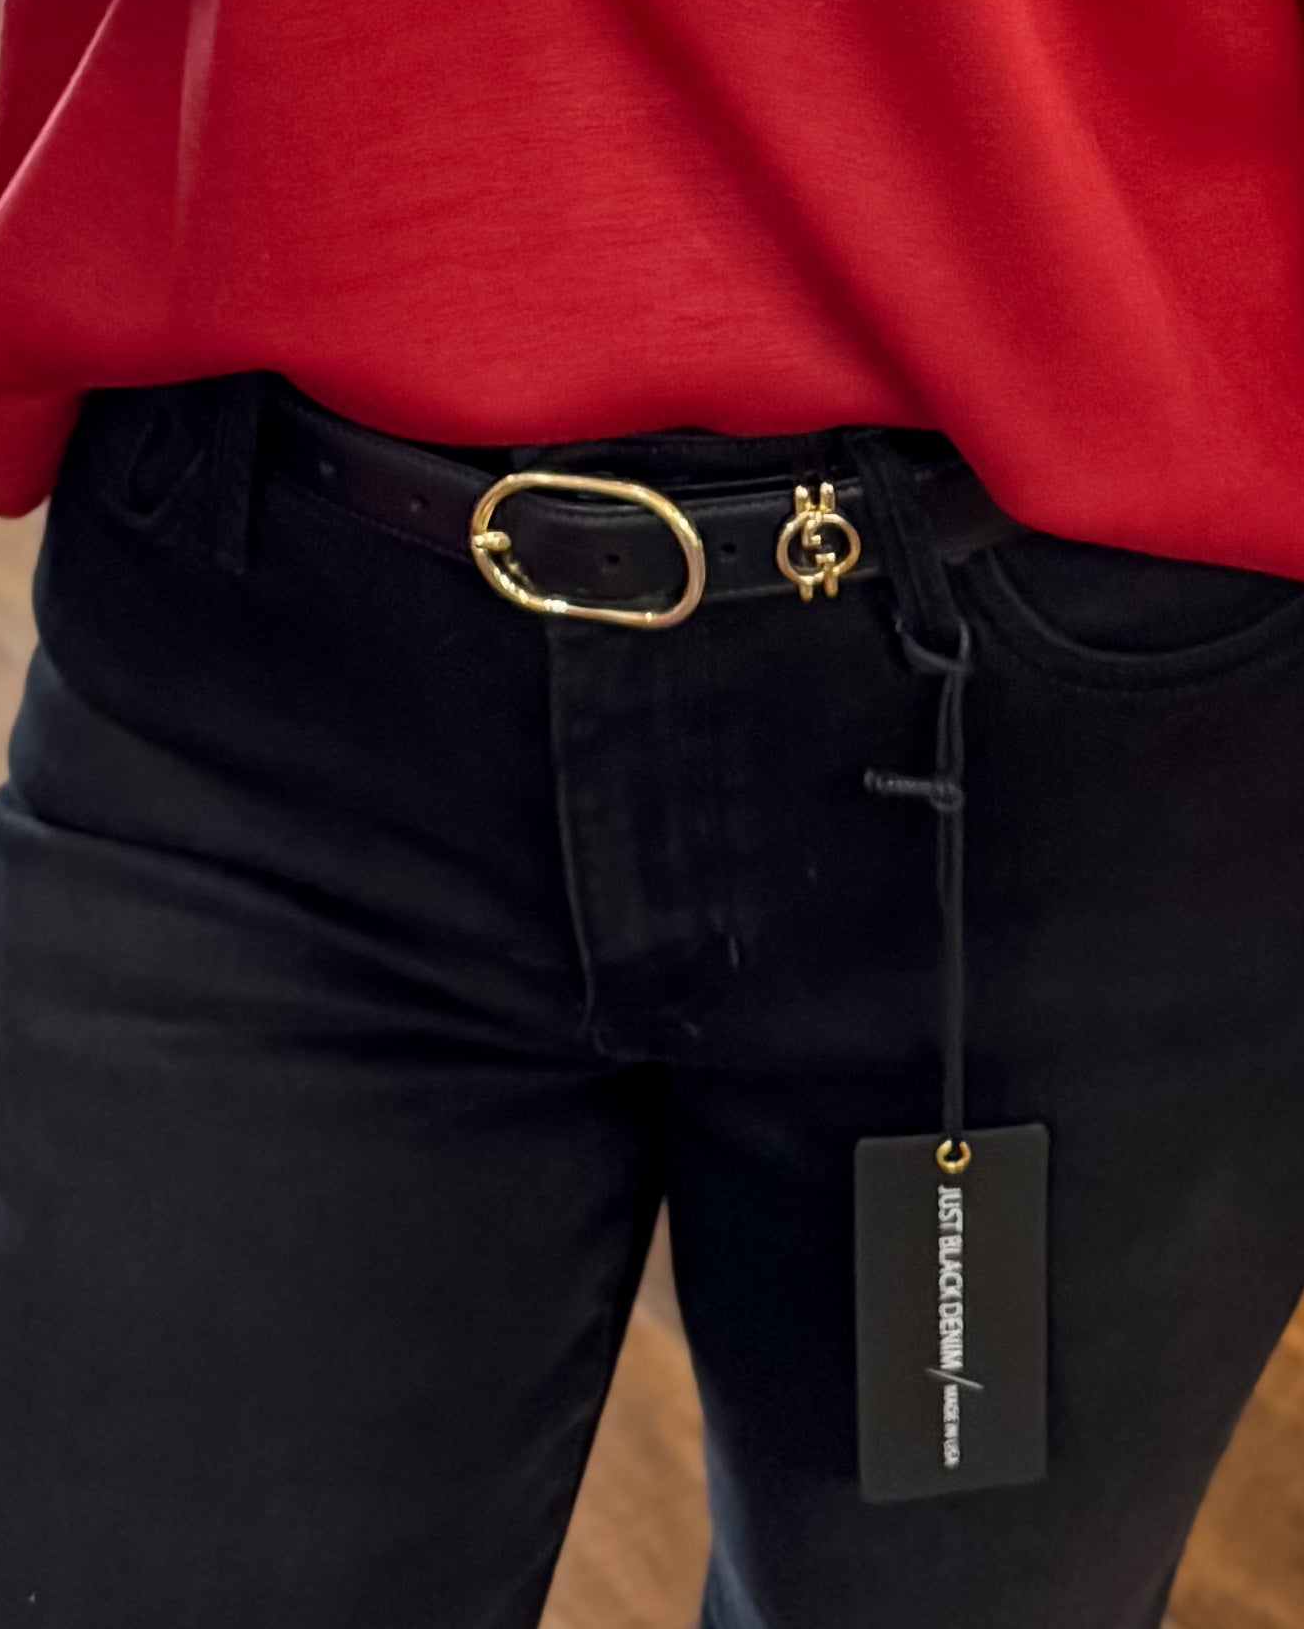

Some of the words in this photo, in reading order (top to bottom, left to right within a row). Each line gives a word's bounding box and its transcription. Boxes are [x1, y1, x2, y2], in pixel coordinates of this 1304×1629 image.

[938, 1185, 963, 1233] JUST
[938, 1235, 963, 1301] BLACK
[938, 1302, 964, 1370] DENIM
